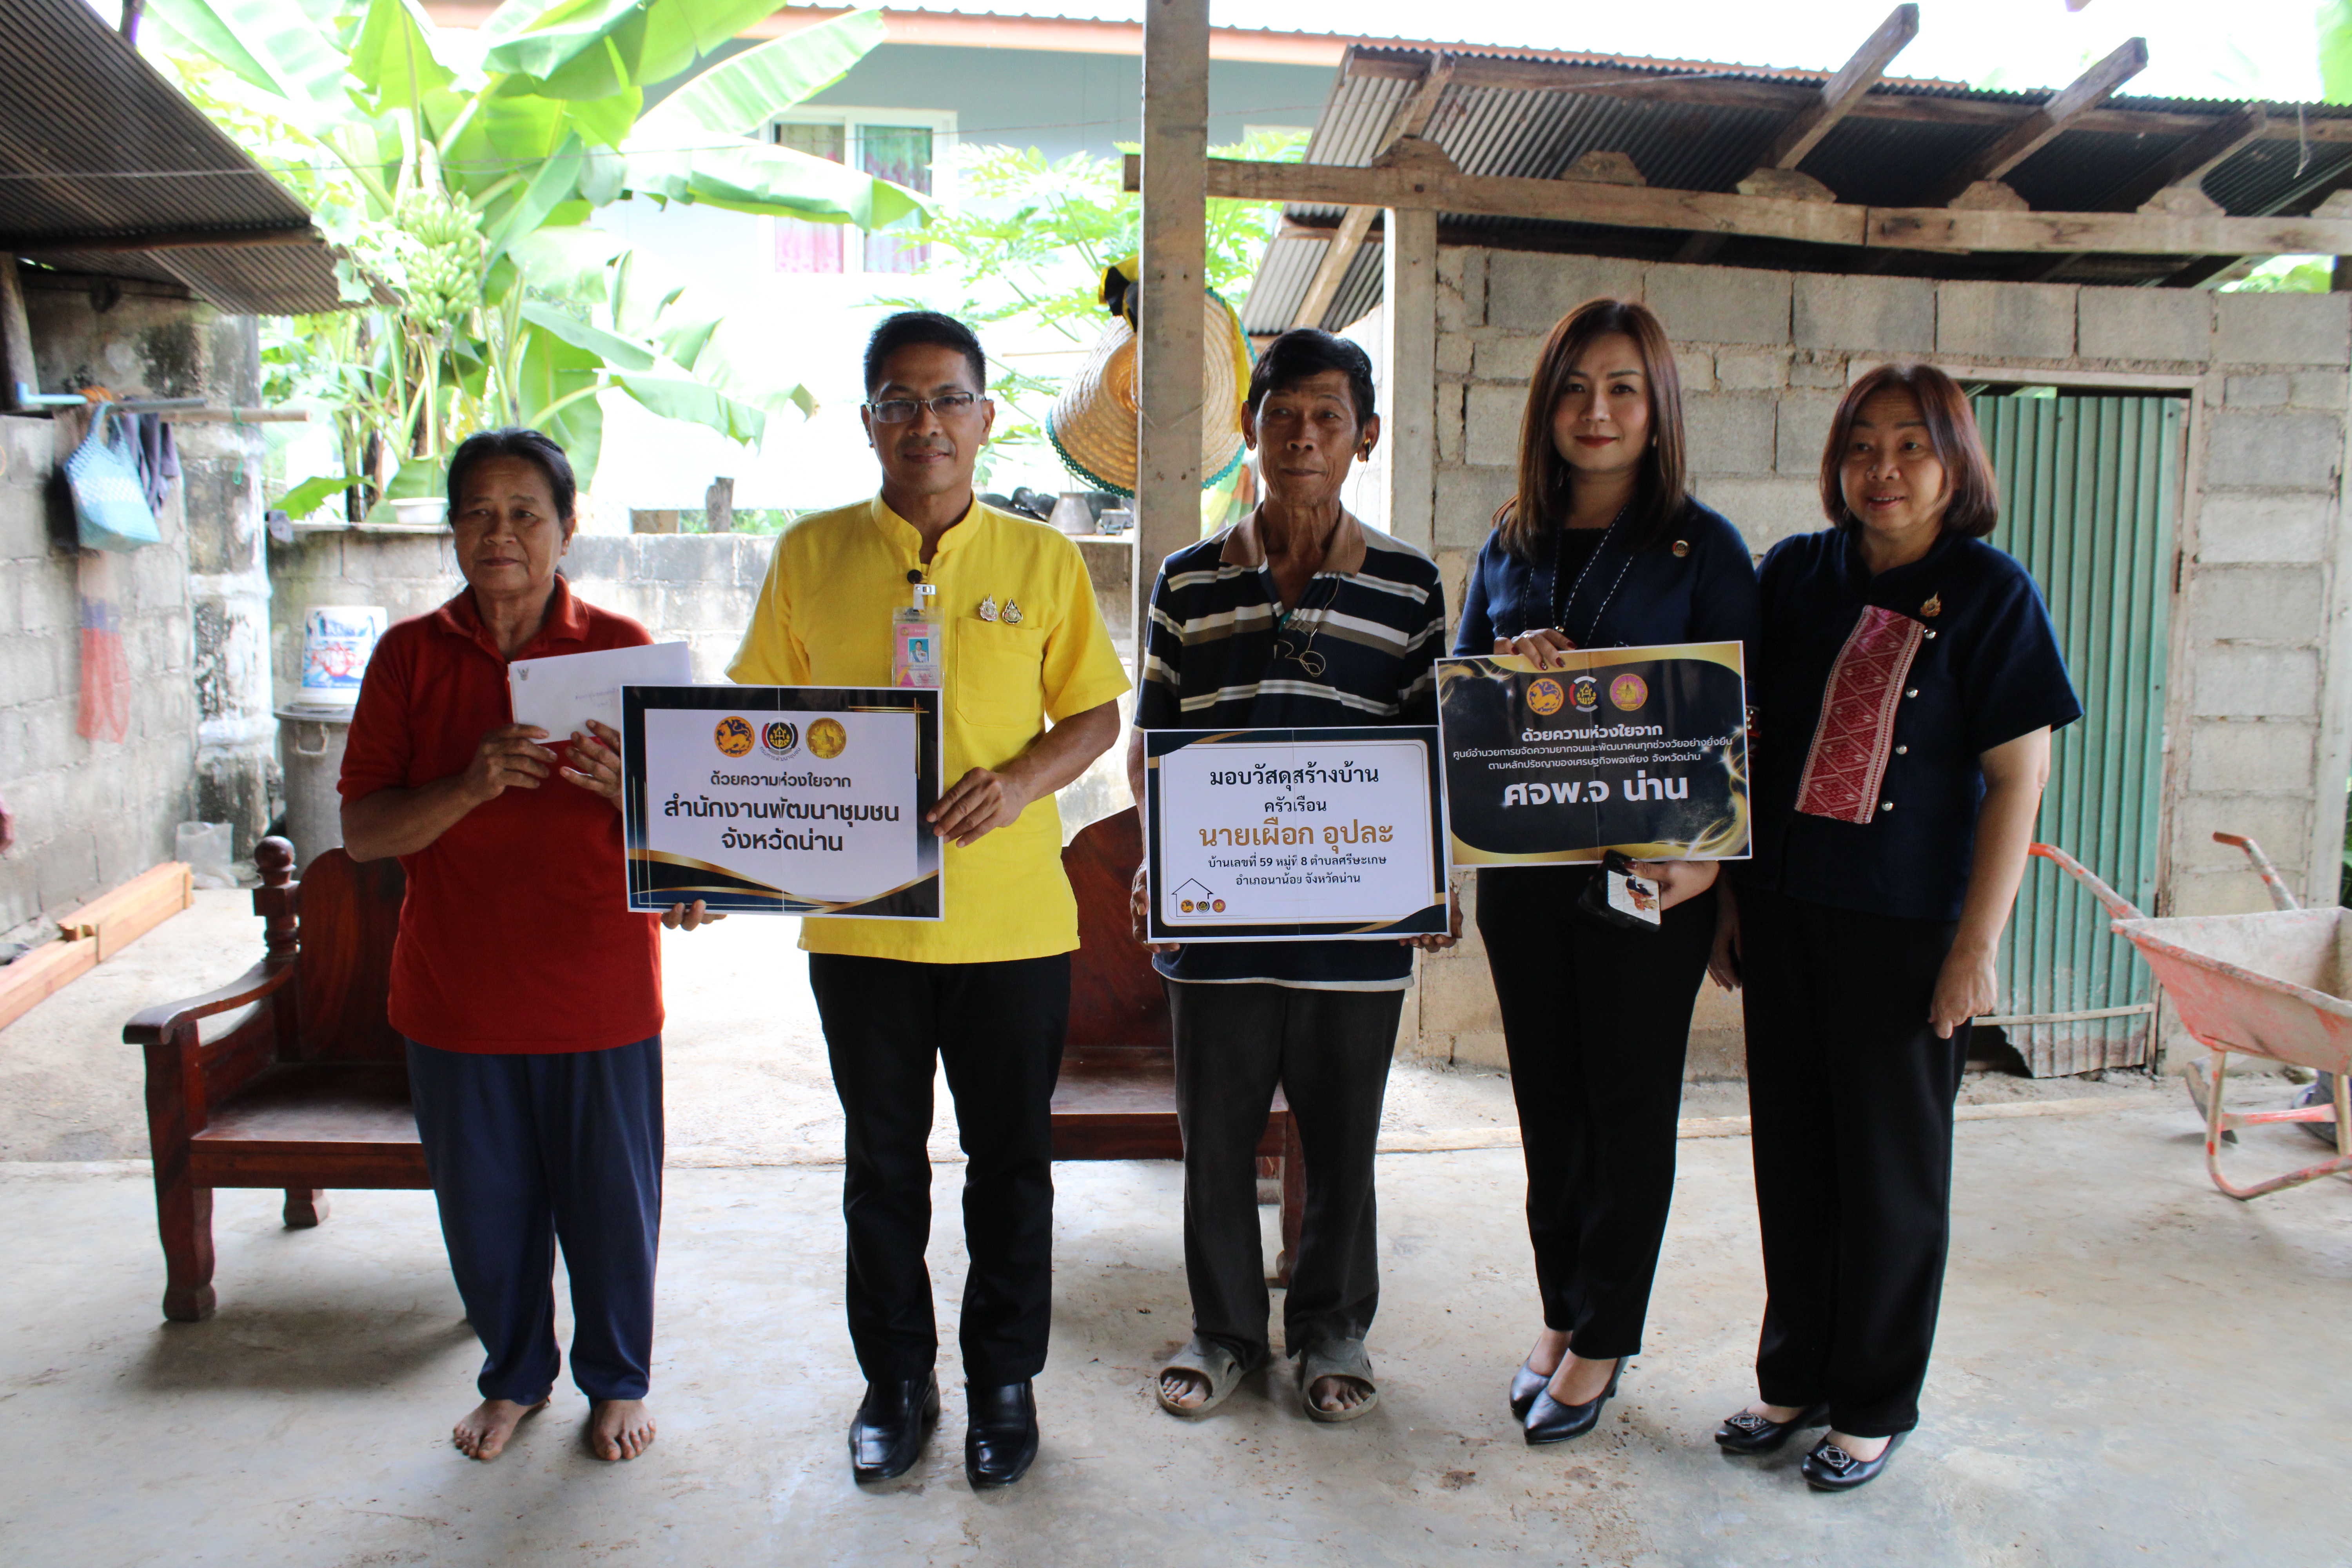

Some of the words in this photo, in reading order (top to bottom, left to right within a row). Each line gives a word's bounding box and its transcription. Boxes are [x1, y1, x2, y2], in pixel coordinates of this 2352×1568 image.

[1521, 724, 1663, 742] ด้วยความห่วงใยจาก
[1453, 736, 1733, 760] ศูนย์อำนวยการขจัดความยากจนและพัฒนาคนทุกช่วงวัยอย่างยั่งยืน
[1488, 754, 1649, 770] ตามหลักปรัชญาของเศรษฐกิจพอเพียง
[1652, 752, 1702, 763] จังหวัดน่าน
[710, 770, 851, 788] ด้วยความห่วงใยจาก
[1210, 760, 1379, 791] มอบวัสดุสร้างบ้าน
[1504, 780, 1610, 807] ศจพ.จ
[1624, 770, 1688, 801] น่าน
[664, 793, 899, 827] สำนักงานพัฒนาชุมชน
[1265, 795, 1327, 813] ครัวเรือน
[721, 827, 843, 852] จังหวัดน่าน
[1199, 817, 1314, 847] นายเผือก
[1323, 819, 1394, 854] อุปละ
[1208, 852, 1257, 867] บ้านเลขที่
[1260, 857, 1273, 867] 59
[1276, 855, 1298, 871] หมู่ที
[1301, 857, 1308, 866] 8
[1310, 853, 1387, 866] ตำบลศรีษะเกษ
[1236, 872, 1302, 885] อำเภอนาน้อย
[1305, 871, 1361, 884] จังหวัดน่าน
